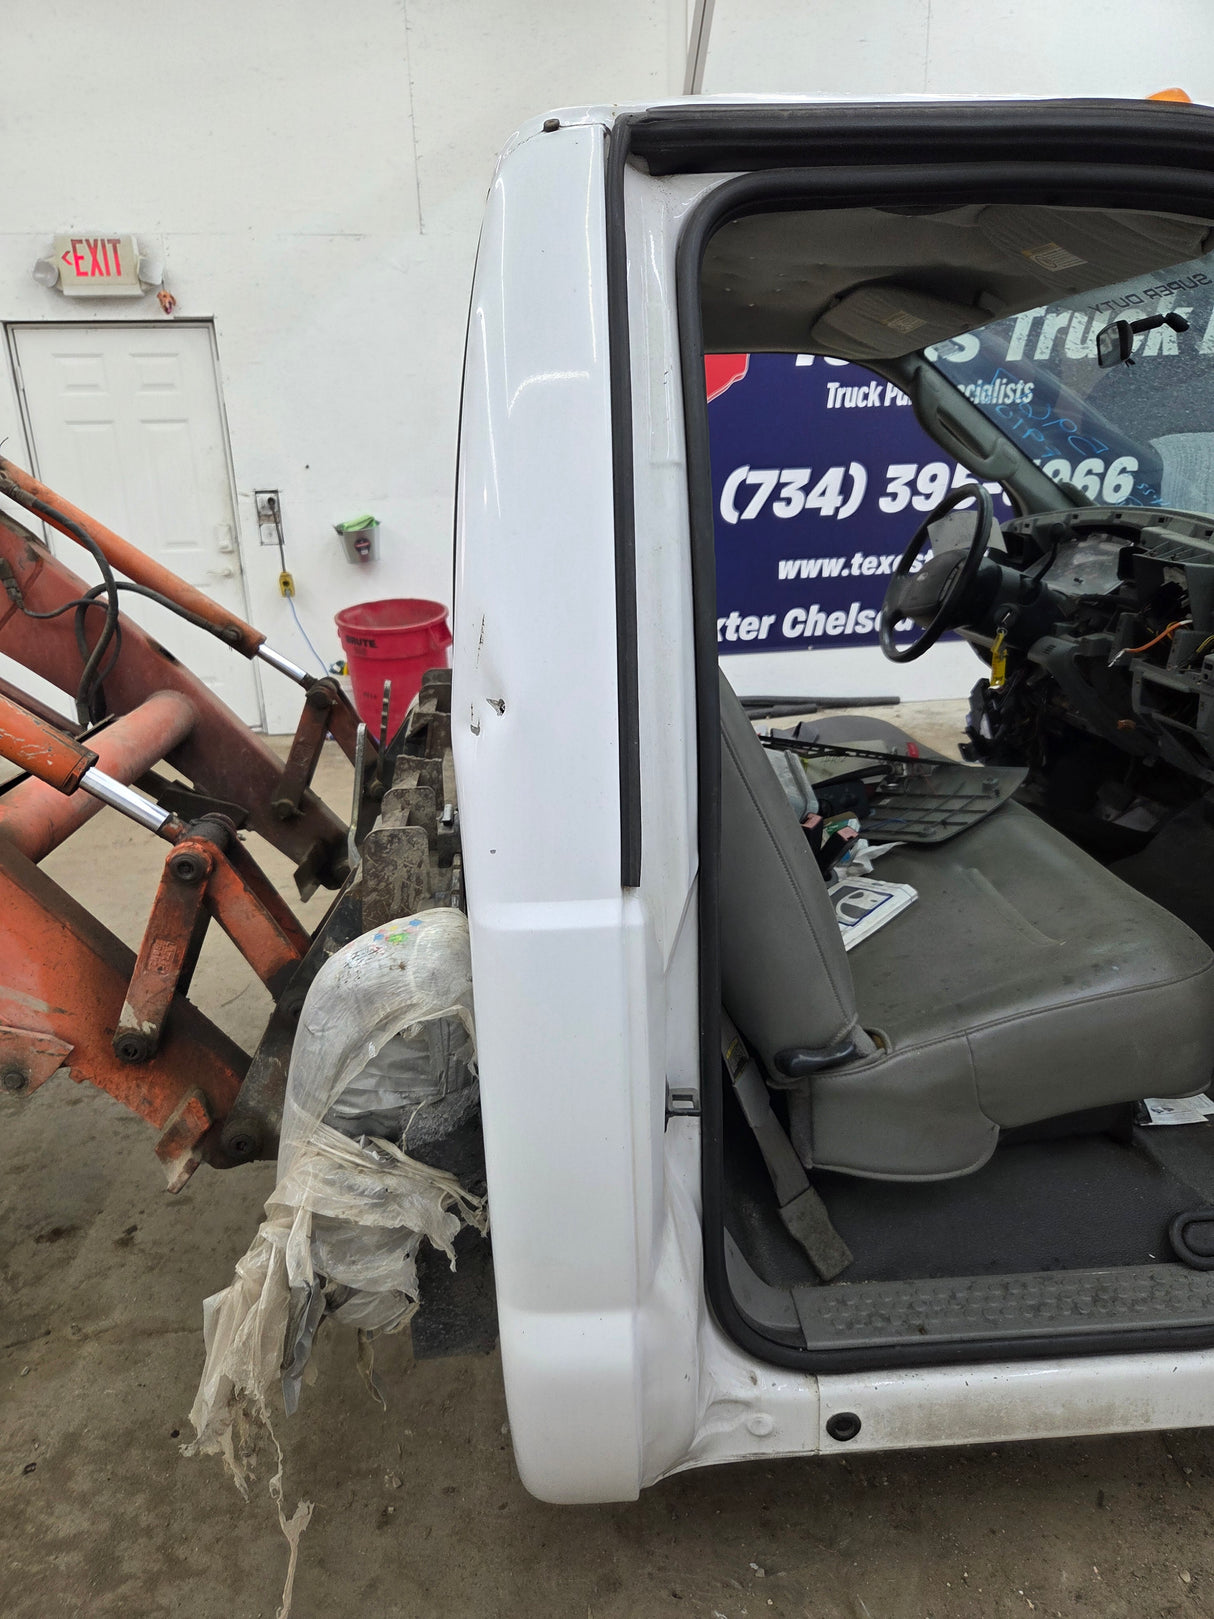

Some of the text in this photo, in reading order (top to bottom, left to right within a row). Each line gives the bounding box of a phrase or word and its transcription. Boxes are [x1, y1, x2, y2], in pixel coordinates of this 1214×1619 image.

[70, 238, 121, 277] EXIT
[826, 381, 883, 409] Truck
[720, 462, 868, 525] (734)
